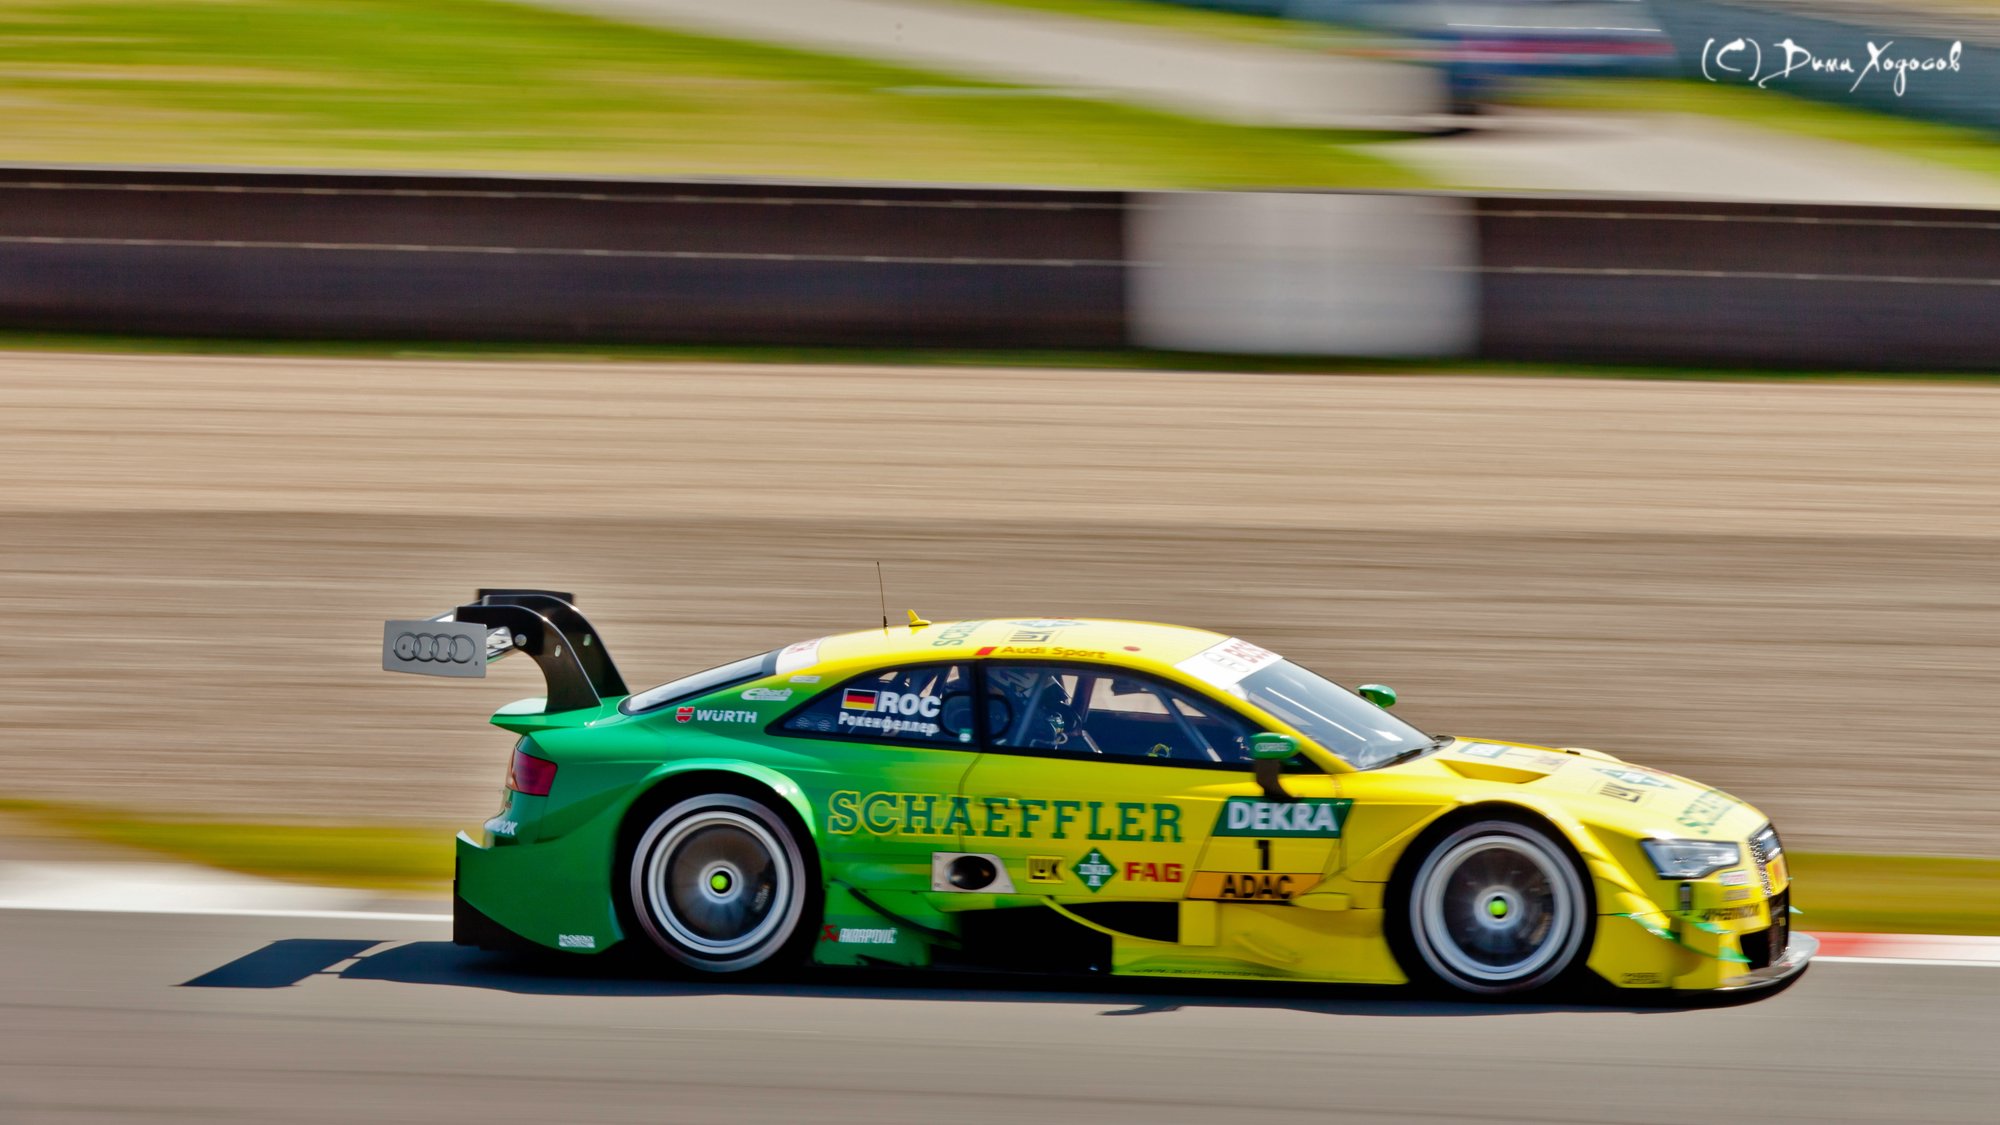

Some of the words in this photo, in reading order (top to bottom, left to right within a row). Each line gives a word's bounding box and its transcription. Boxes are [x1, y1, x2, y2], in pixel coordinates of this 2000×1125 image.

[1001, 646, 1046, 655] Audi
[1052, 647, 1107, 659] Sport
[877, 691, 942, 718] ROC
[838, 711, 940, 738] Рокенфеллер
[827, 790, 1184, 843] SCHAEFFLER
[1227, 801, 1339, 831] DEKRA
[1255, 839, 1271, 871] 1
[1124, 861, 1184, 883] FAG
[1220, 874, 1293, 899] ADAC
